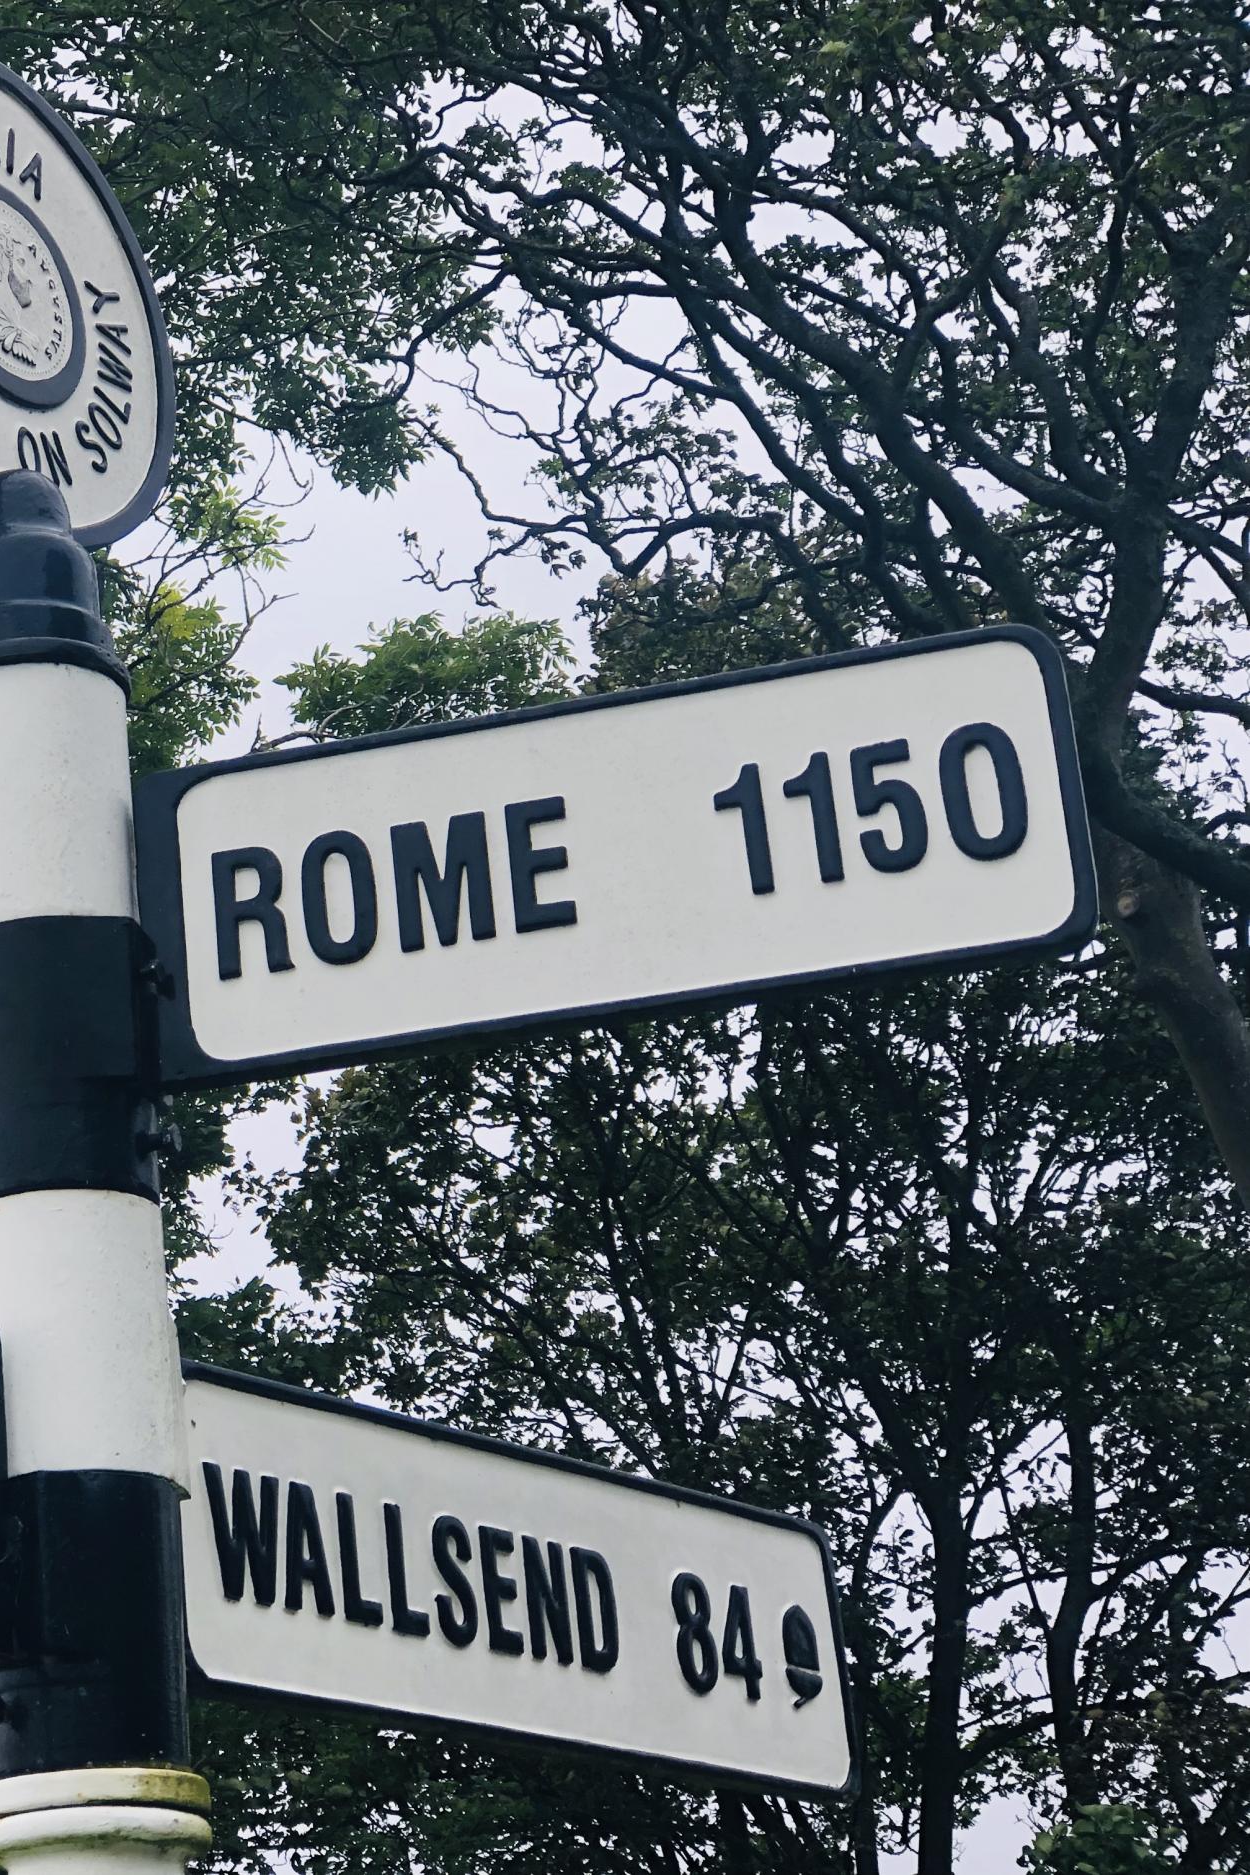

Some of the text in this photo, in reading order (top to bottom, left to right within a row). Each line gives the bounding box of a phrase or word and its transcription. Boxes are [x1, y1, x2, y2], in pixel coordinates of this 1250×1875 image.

[18, 426, 72, 486] ON
[75, 280, 132, 473] SOLWAY
[211, 721, 1029, 981] ROME 1150
[202, 1462, 762, 1701] WALLSEND 84
